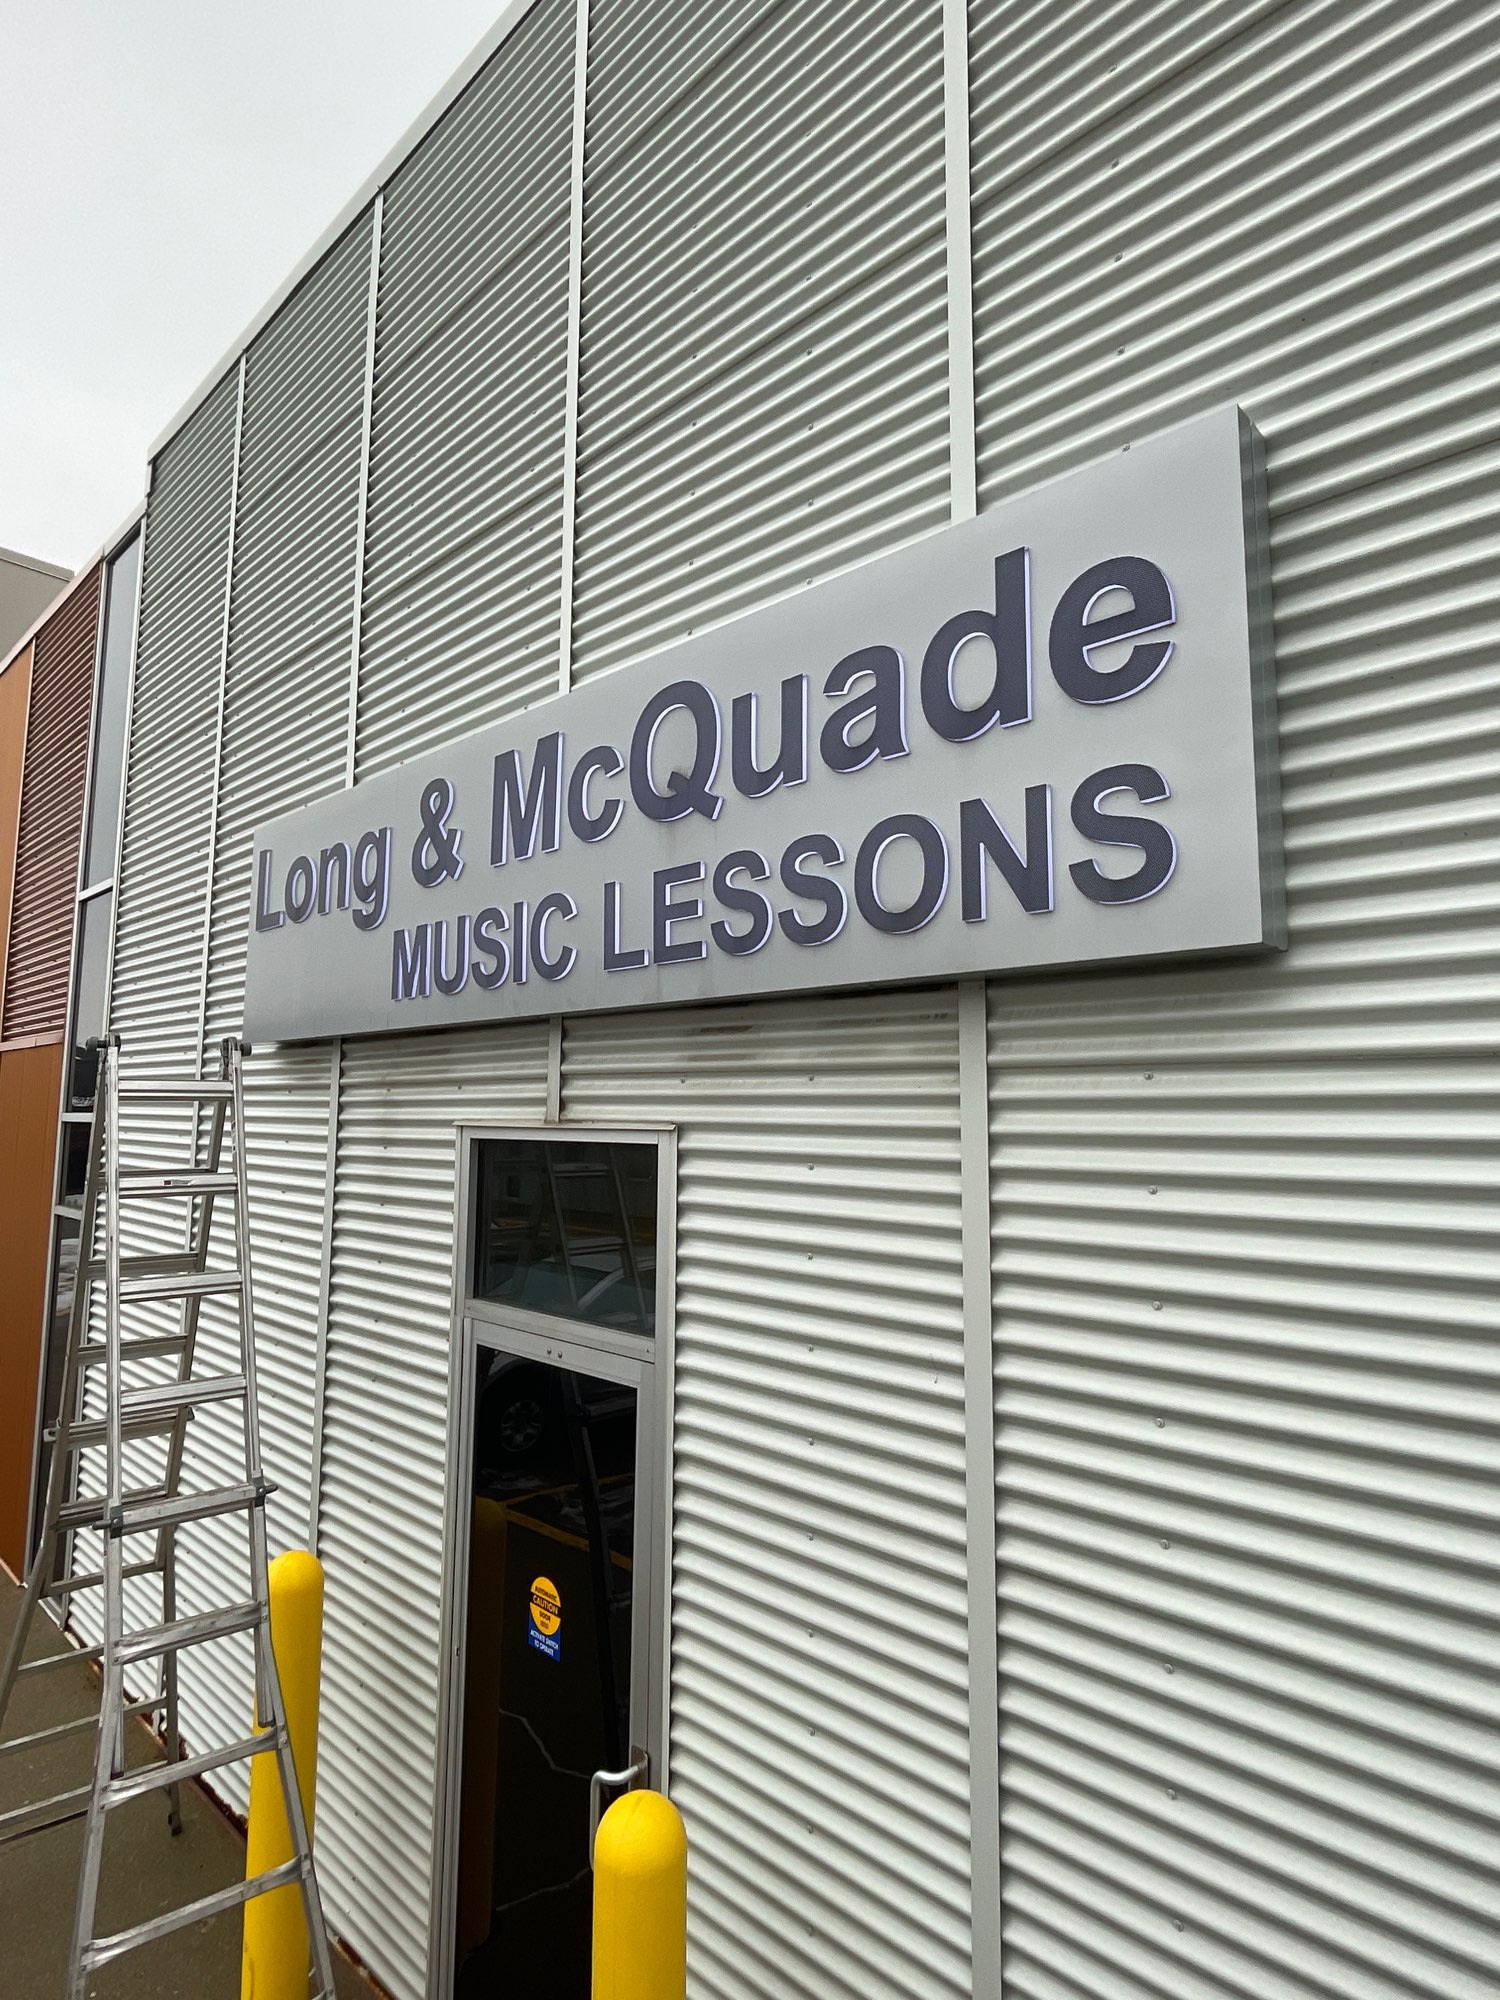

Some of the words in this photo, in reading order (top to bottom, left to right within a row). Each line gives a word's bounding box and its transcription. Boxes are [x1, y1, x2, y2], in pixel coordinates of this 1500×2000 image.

[255, 825, 393, 933] Long
[411, 777, 464, 889] &
[489, 545, 1177, 869] McQuade
[391, 891, 579, 1001] MUSIC
[603, 762, 1178, 973] LESSONS
[534, 1585, 557, 1603] AUTOMATIC
[532, 1594, 559, 1615] CAUTION
[539, 1610, 551, 1622] DOOR
[530, 1629, 546, 1643] ACTIVATE
